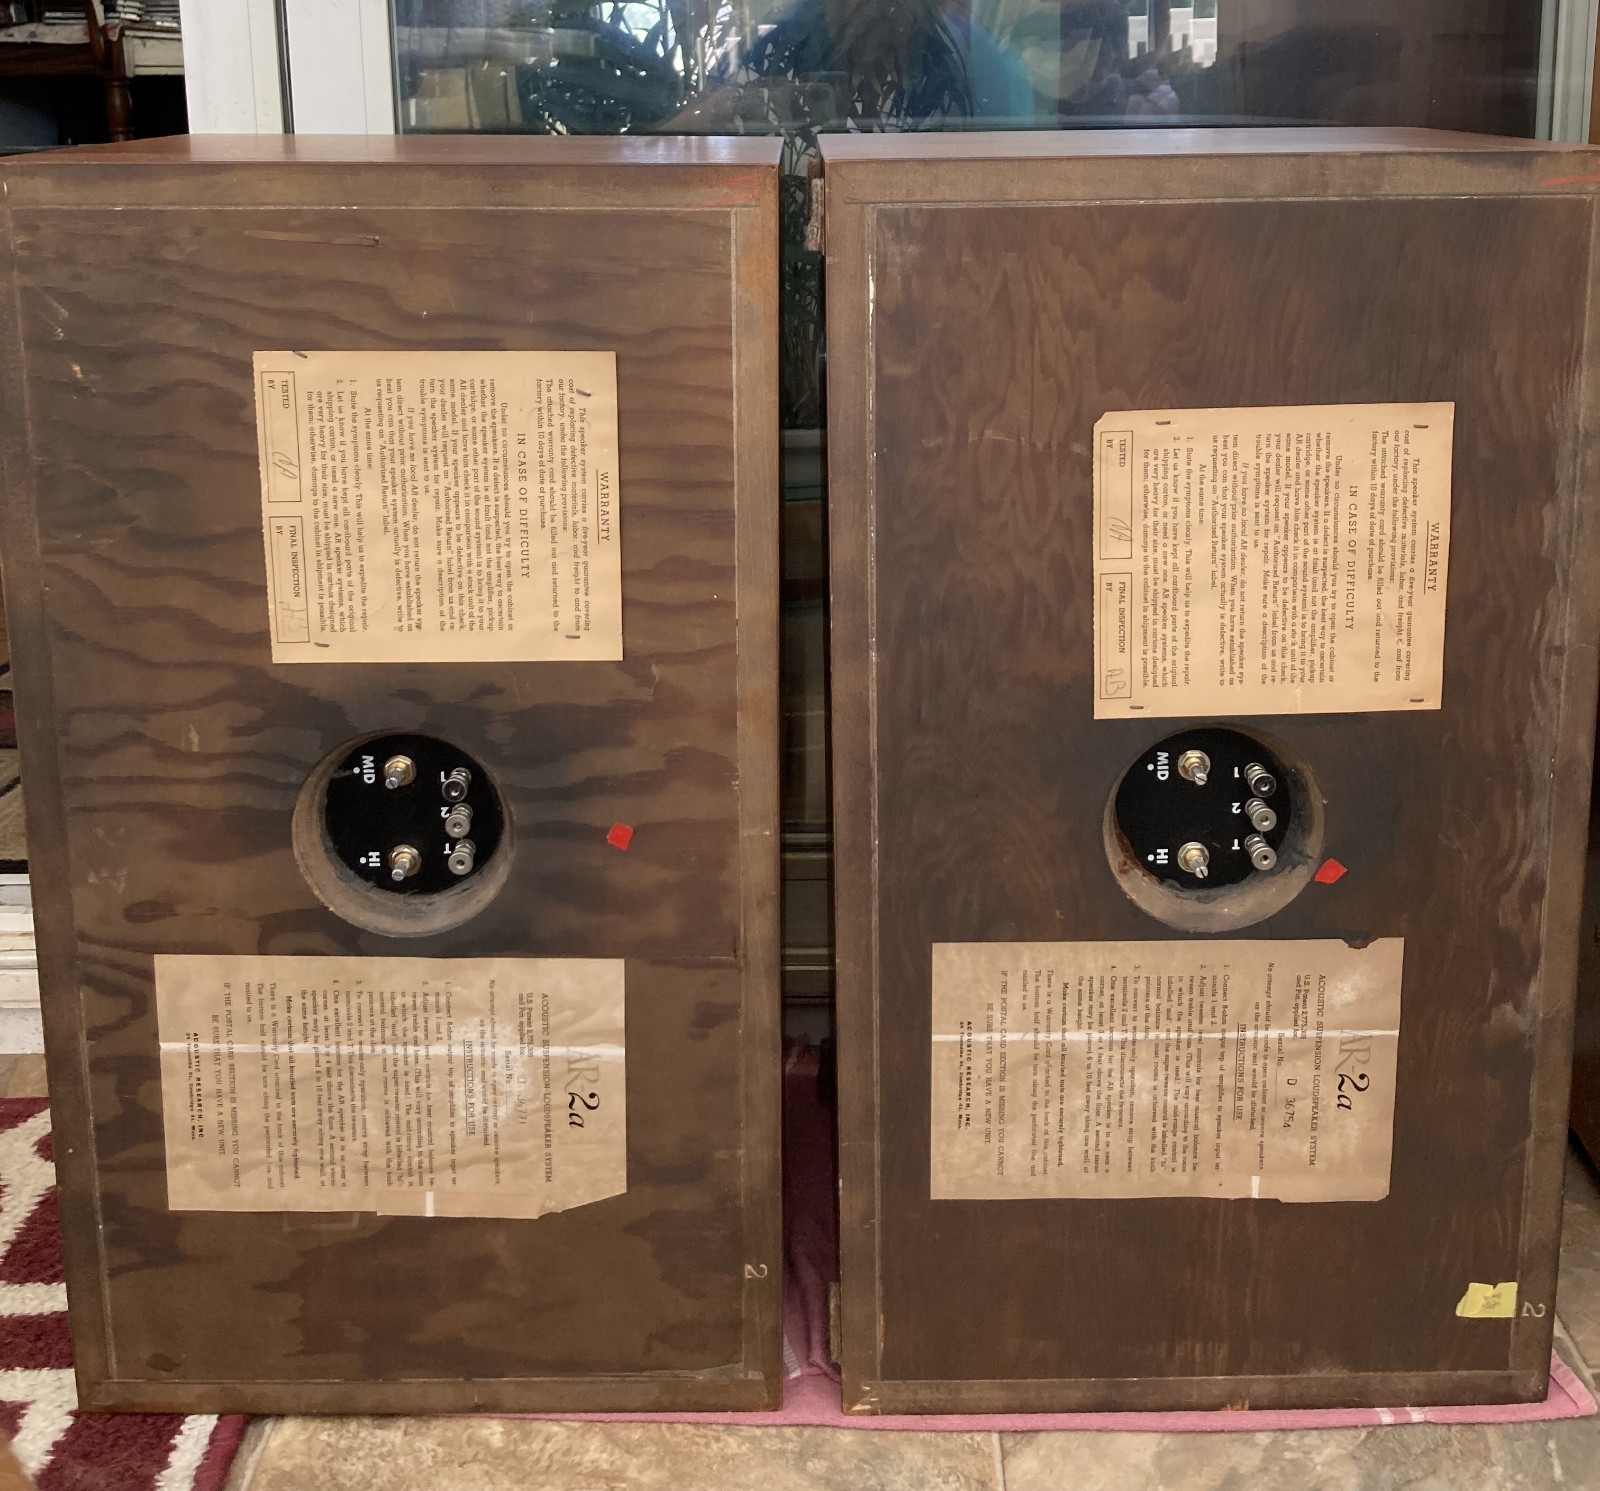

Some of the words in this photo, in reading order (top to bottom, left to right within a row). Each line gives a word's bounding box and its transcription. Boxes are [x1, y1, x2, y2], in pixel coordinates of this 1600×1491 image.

[268, 380, 275, 389] BY
[282, 380, 290, 408] TESTED
[518, 433, 525, 444] IN
[1106, 440, 1113, 448] BY
[520, 488, 527, 502] OF
[1350, 485, 1357, 497] IN
[538, 496, 546, 530] purchase.
[600, 472, 610, 542] WARRANTY
[1241, 508, 1246, 516] no
[550, 515, 556, 523] be
[1349, 504, 1357, 534] CASE
[276, 526, 282, 534] BY
[1184, 521, 1192, 547] clearly.
[520, 509, 529, 578] DIFFICULTY
[1241, 539, 1247, 550] AR
[1348, 540, 1356, 555] OF
[1428, 522, 1439, 591] WARRANTY
[291, 552, 300, 597] INSPECTION
[1106, 582, 1112, 592] BY
[1240, 580, 1246, 588] do
[1346, 561, 1355, 629] DIFFICULTY
[362, 755, 376, 784] MID
[1156, 752, 1168, 780] MID
[1233, 767, 1240, 778] 1
[440, 806, 450, 818] 2
[1232, 802, 1241, 813] 2
[1232, 838, 1240, 850] T
[368, 852, 380, 867] HI
[1156, 848, 1168, 864] HI
[1317, 974, 1326, 1017] ACOUSTIC
[987, 1003, 993, 1011] BE
[212, 1015, 218, 1023] BE
[1238, 1024, 1246, 1082] INSTRUCTIONS
[1314, 1021, 1323, 1070] SUSPENSION
[466, 1041, 474, 1098] INSTRUCTIONS
[1335, 1028, 1373, 1110] AR-2a
[1311, 1075, 1320, 1131] LOUDSPEAKER
[744, 1264, 768, 1278] 2
[1522, 1302, 1546, 1318] 2
